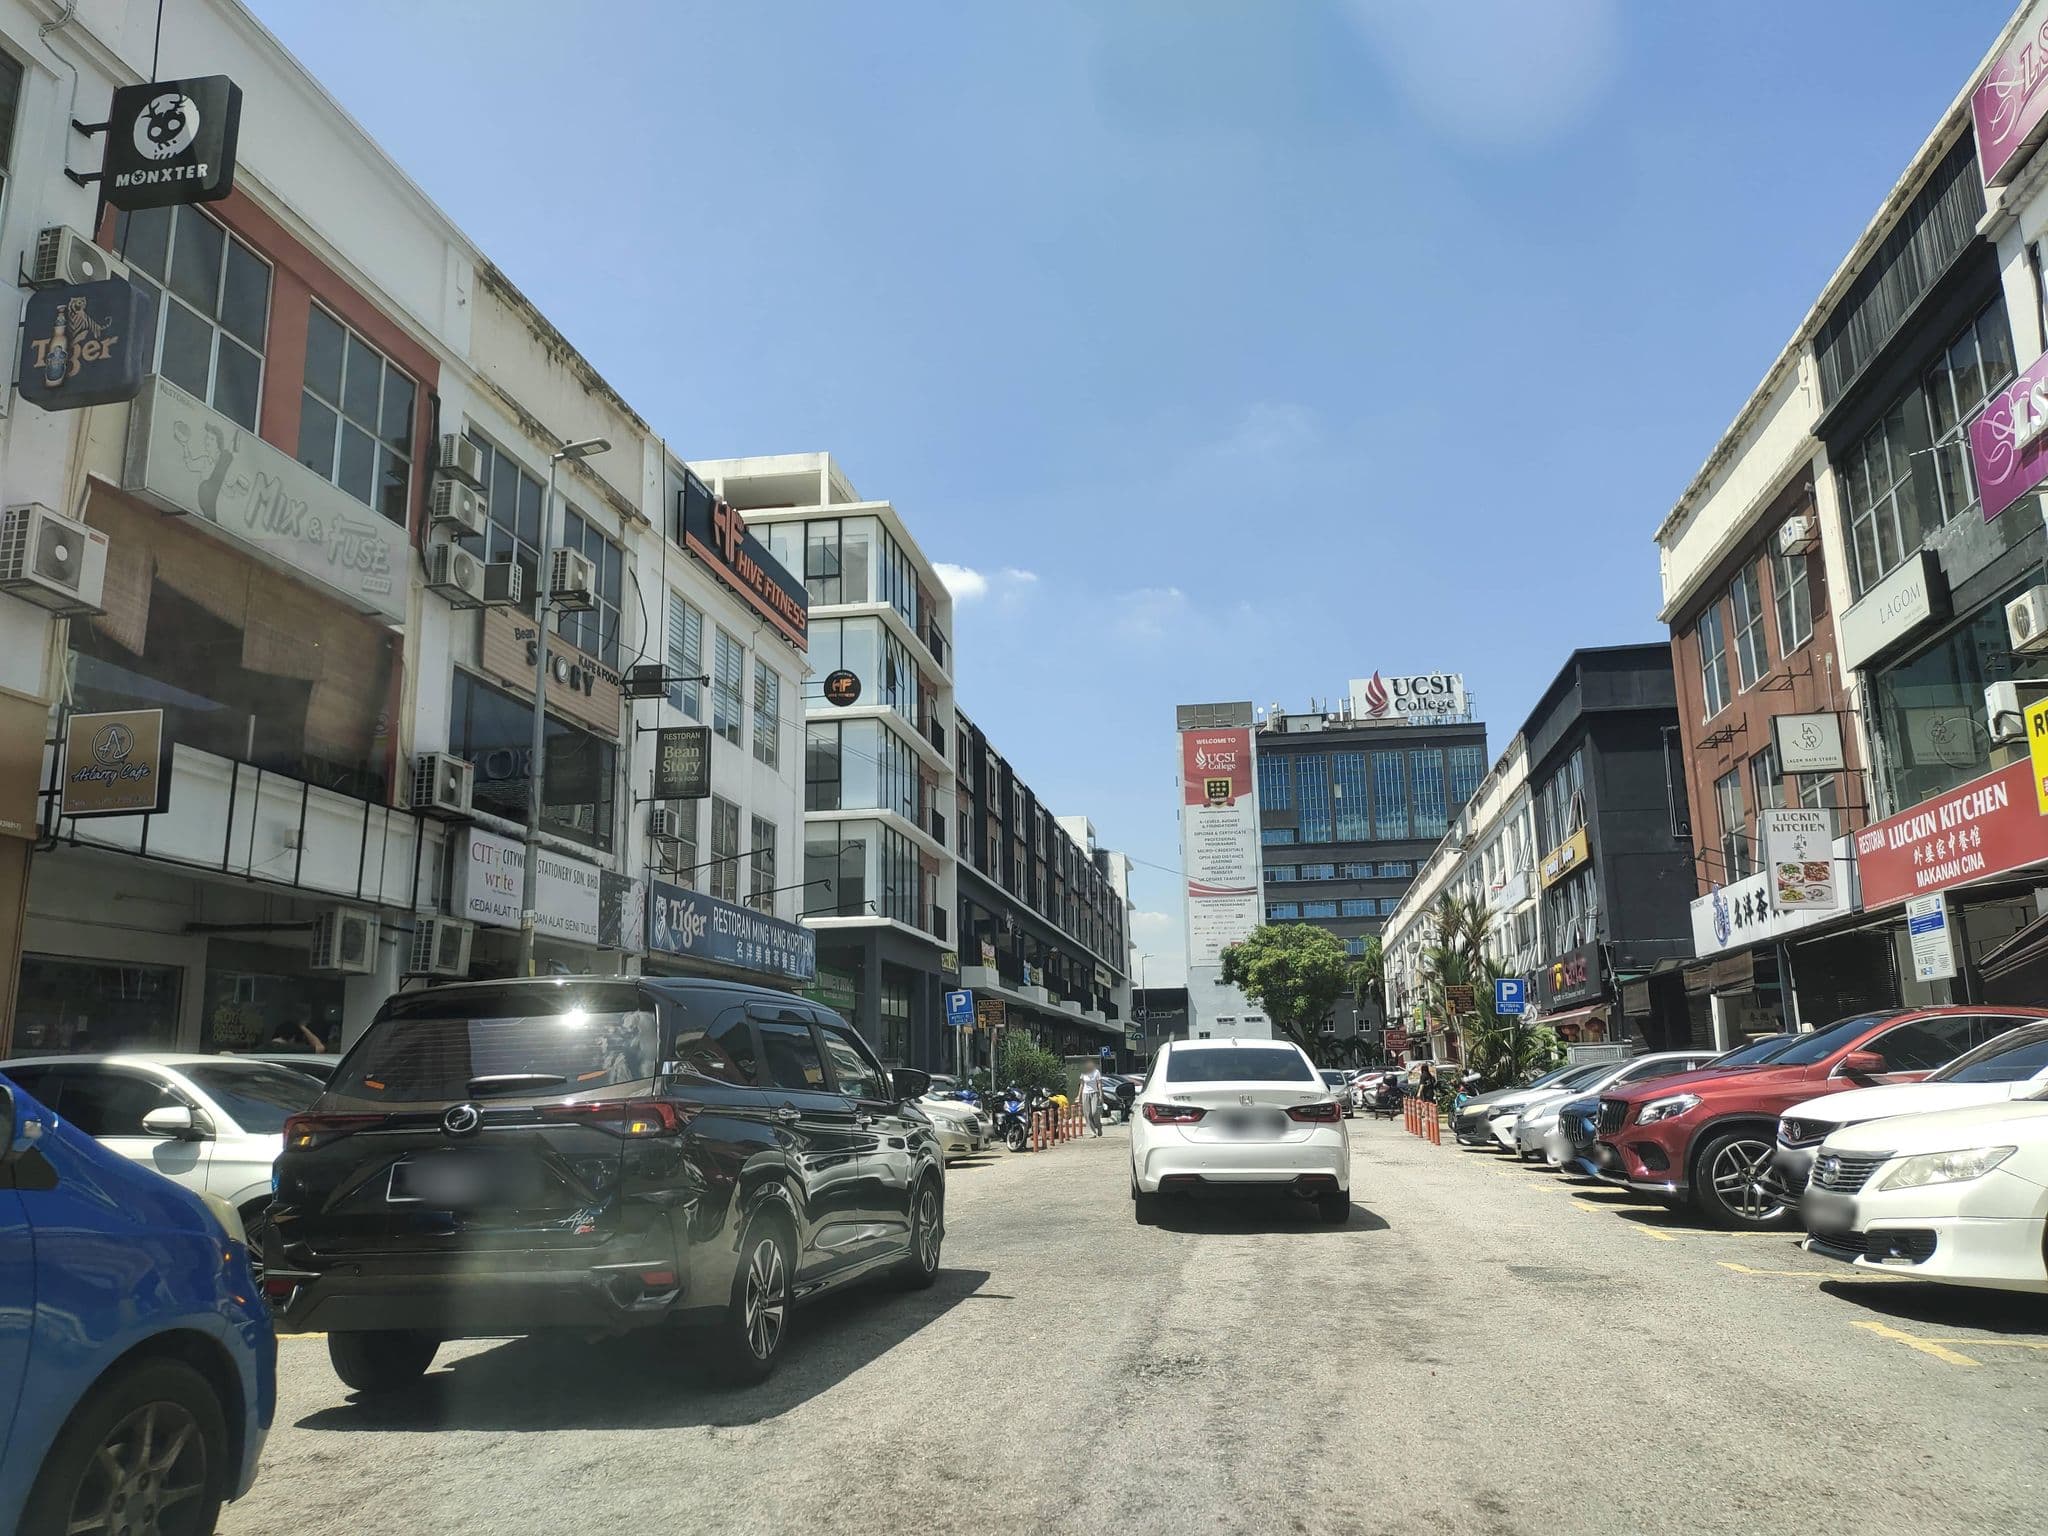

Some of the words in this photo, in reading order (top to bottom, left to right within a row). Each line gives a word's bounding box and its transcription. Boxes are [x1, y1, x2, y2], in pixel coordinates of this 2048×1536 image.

[115, 162, 209, 188] MONXTER
[738, 550, 765, 592] HIVE
[765, 577, 806, 629] FITNESS
[1879, 582, 1921, 625] LAGOM
[514, 627, 536, 640] Bean
[1390, 675, 1454, 697] UCSI
[1395, 697, 1455, 714] College
[663, 732, 701, 741] RESTORAN
[664, 745, 700, 759] Bean
[1207, 752, 1236, 763] UCSI
[662, 759, 701, 774] Story
[1208, 763, 1236, 772] College
[1775, 812, 1820, 822] LUCKIN
[1858, 827, 1886, 856] RESTORAN
[1888, 810, 1937, 850] LUCKIN
[1938, 781, 2009, 830] KITCHEN
[1772, 823, 1826, 832] KITCHEN
[537, 859, 573, 882] STATIONERY
[1915, 862, 1961, 888] MAKANAN
[1961, 852, 1986, 874] CINA
[469, 897, 492, 914] KEDAI
[493, 902, 512, 919] ALAT
[548, 916, 564, 929] ALAT
[565, 919, 580, 932] SENI
[670, 898, 707, 949] Tiger
[713, 906, 751, 940] RESTORAN
[752, 921, 769, 945] MING
[769, 925, 787, 950] YANG
[787, 930, 814, 958] KOPITIAM
[1502, 982, 1518, 1001] P
[951, 994, 966, 1012] P
